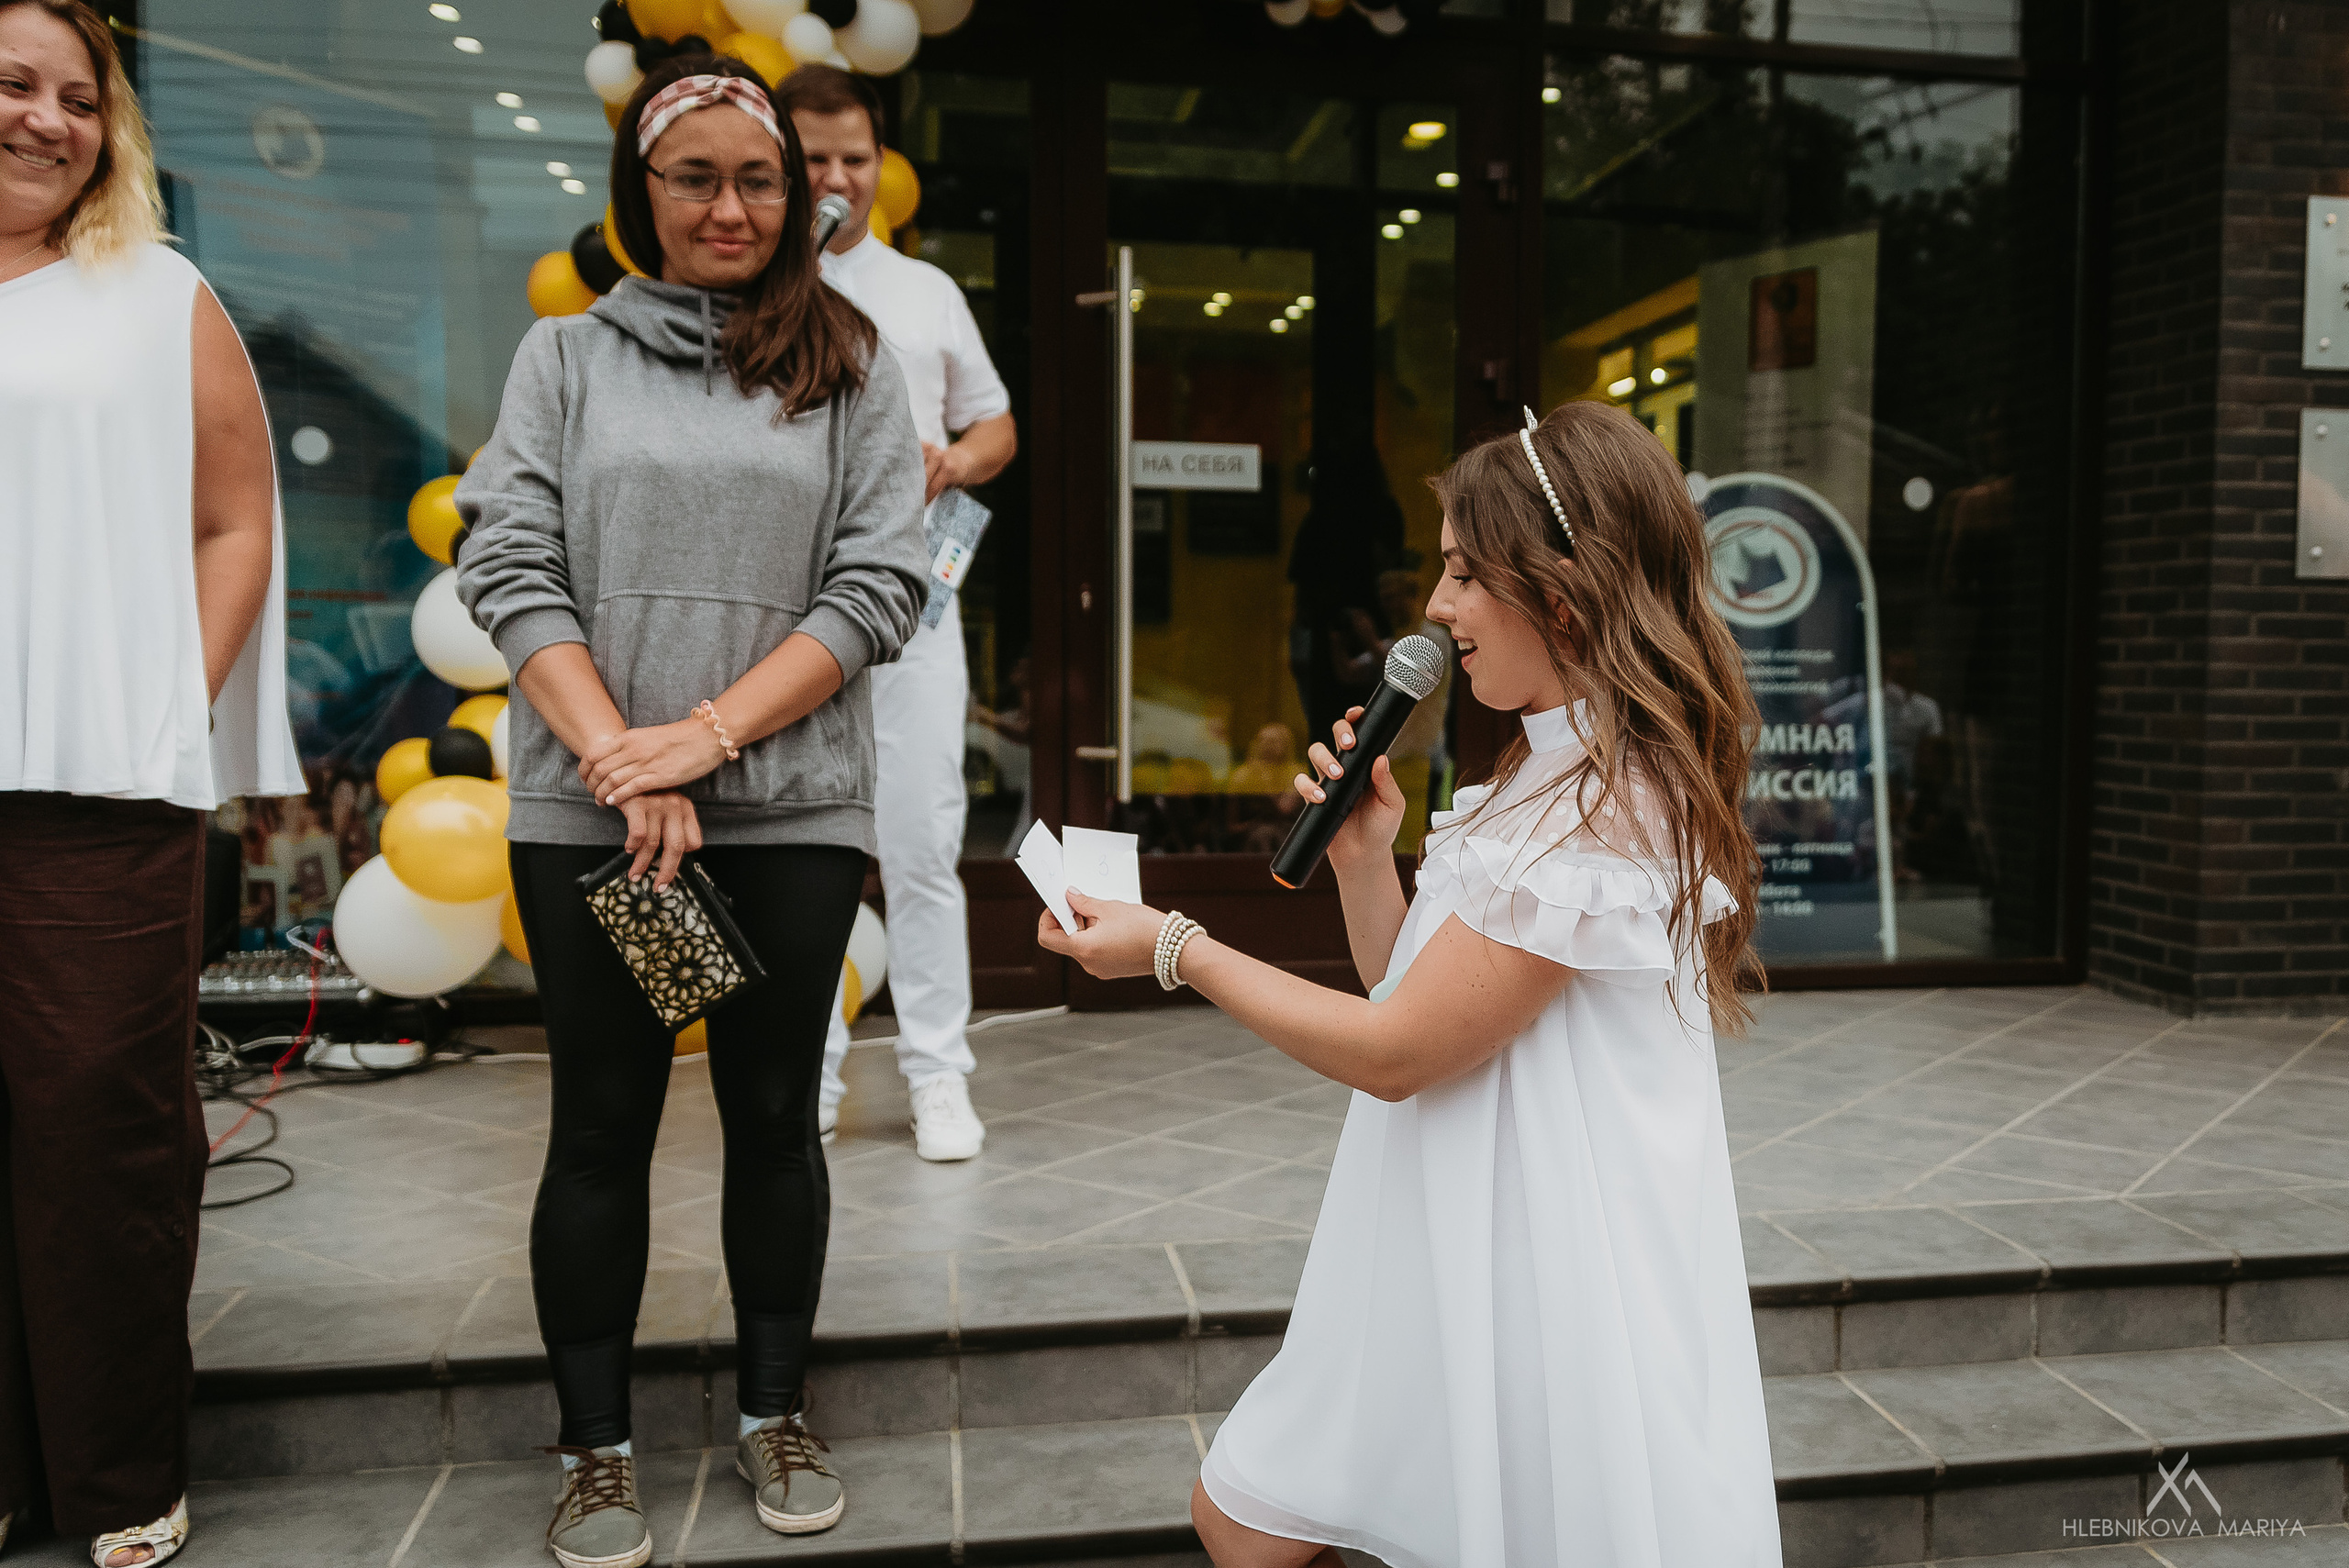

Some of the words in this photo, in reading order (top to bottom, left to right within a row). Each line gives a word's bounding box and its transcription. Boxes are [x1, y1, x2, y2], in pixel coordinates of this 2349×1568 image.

[1141, 454, 1173, 473] НА
[1180, 454, 1244, 475] СЕБЯ
[1745, 768, 1858, 800] ИССИЯ
[1098, 854, 1109, 876] 3
